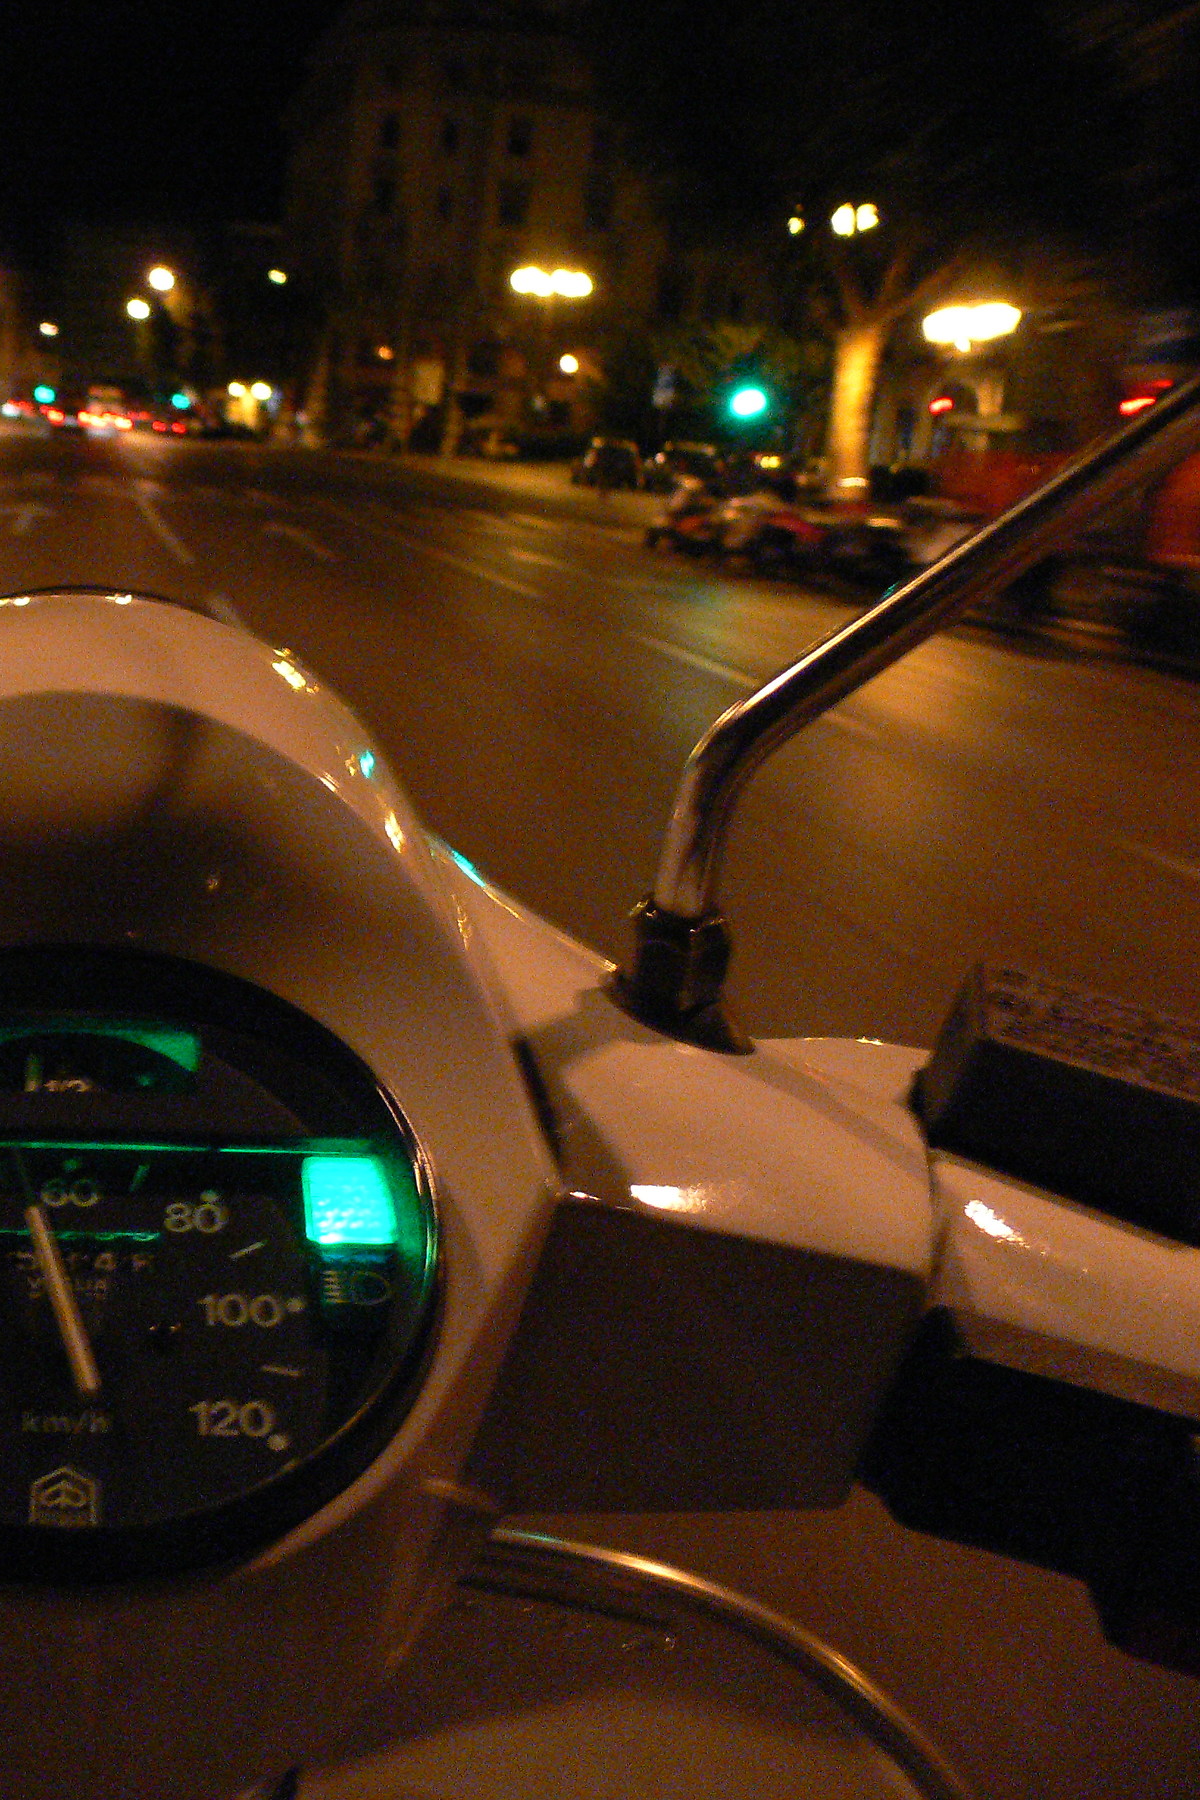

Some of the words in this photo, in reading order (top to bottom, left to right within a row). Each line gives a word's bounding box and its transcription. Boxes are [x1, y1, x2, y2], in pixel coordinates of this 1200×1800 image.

[41, 1177, 102, 1208] 60
[164, 1202, 228, 1234] 80
[199, 1293, 284, 1328] 100
[22, 1410, 112, 1434] km/h
[187, 1400, 274, 1438] 120
